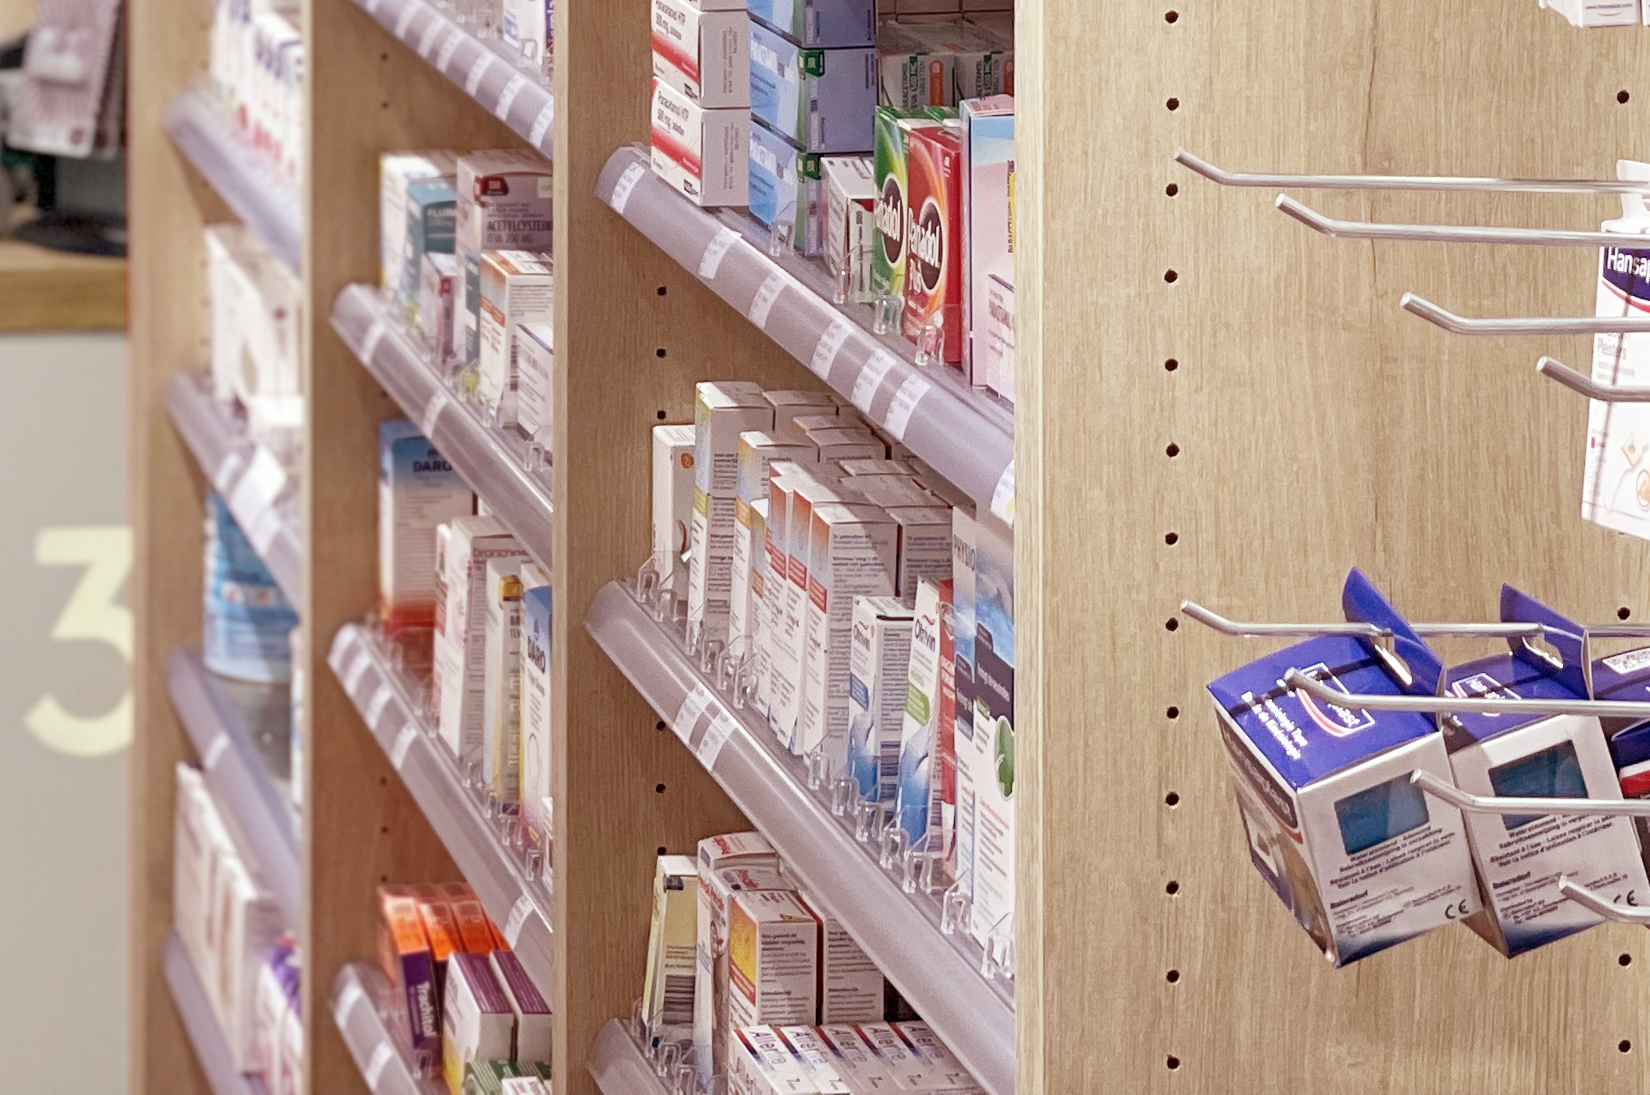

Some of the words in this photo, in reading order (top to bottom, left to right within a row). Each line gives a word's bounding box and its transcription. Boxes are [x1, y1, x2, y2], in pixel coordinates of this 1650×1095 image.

[901, 61, 909, 108] ARACETAMOL
[975, 60, 983, 98] ACETAMOL
[907, 207, 941, 269] Panadol
[413, 460, 453, 473] DARO
[24, 525, 134, 757] 3
[417, 981, 437, 1037] Trachitol
